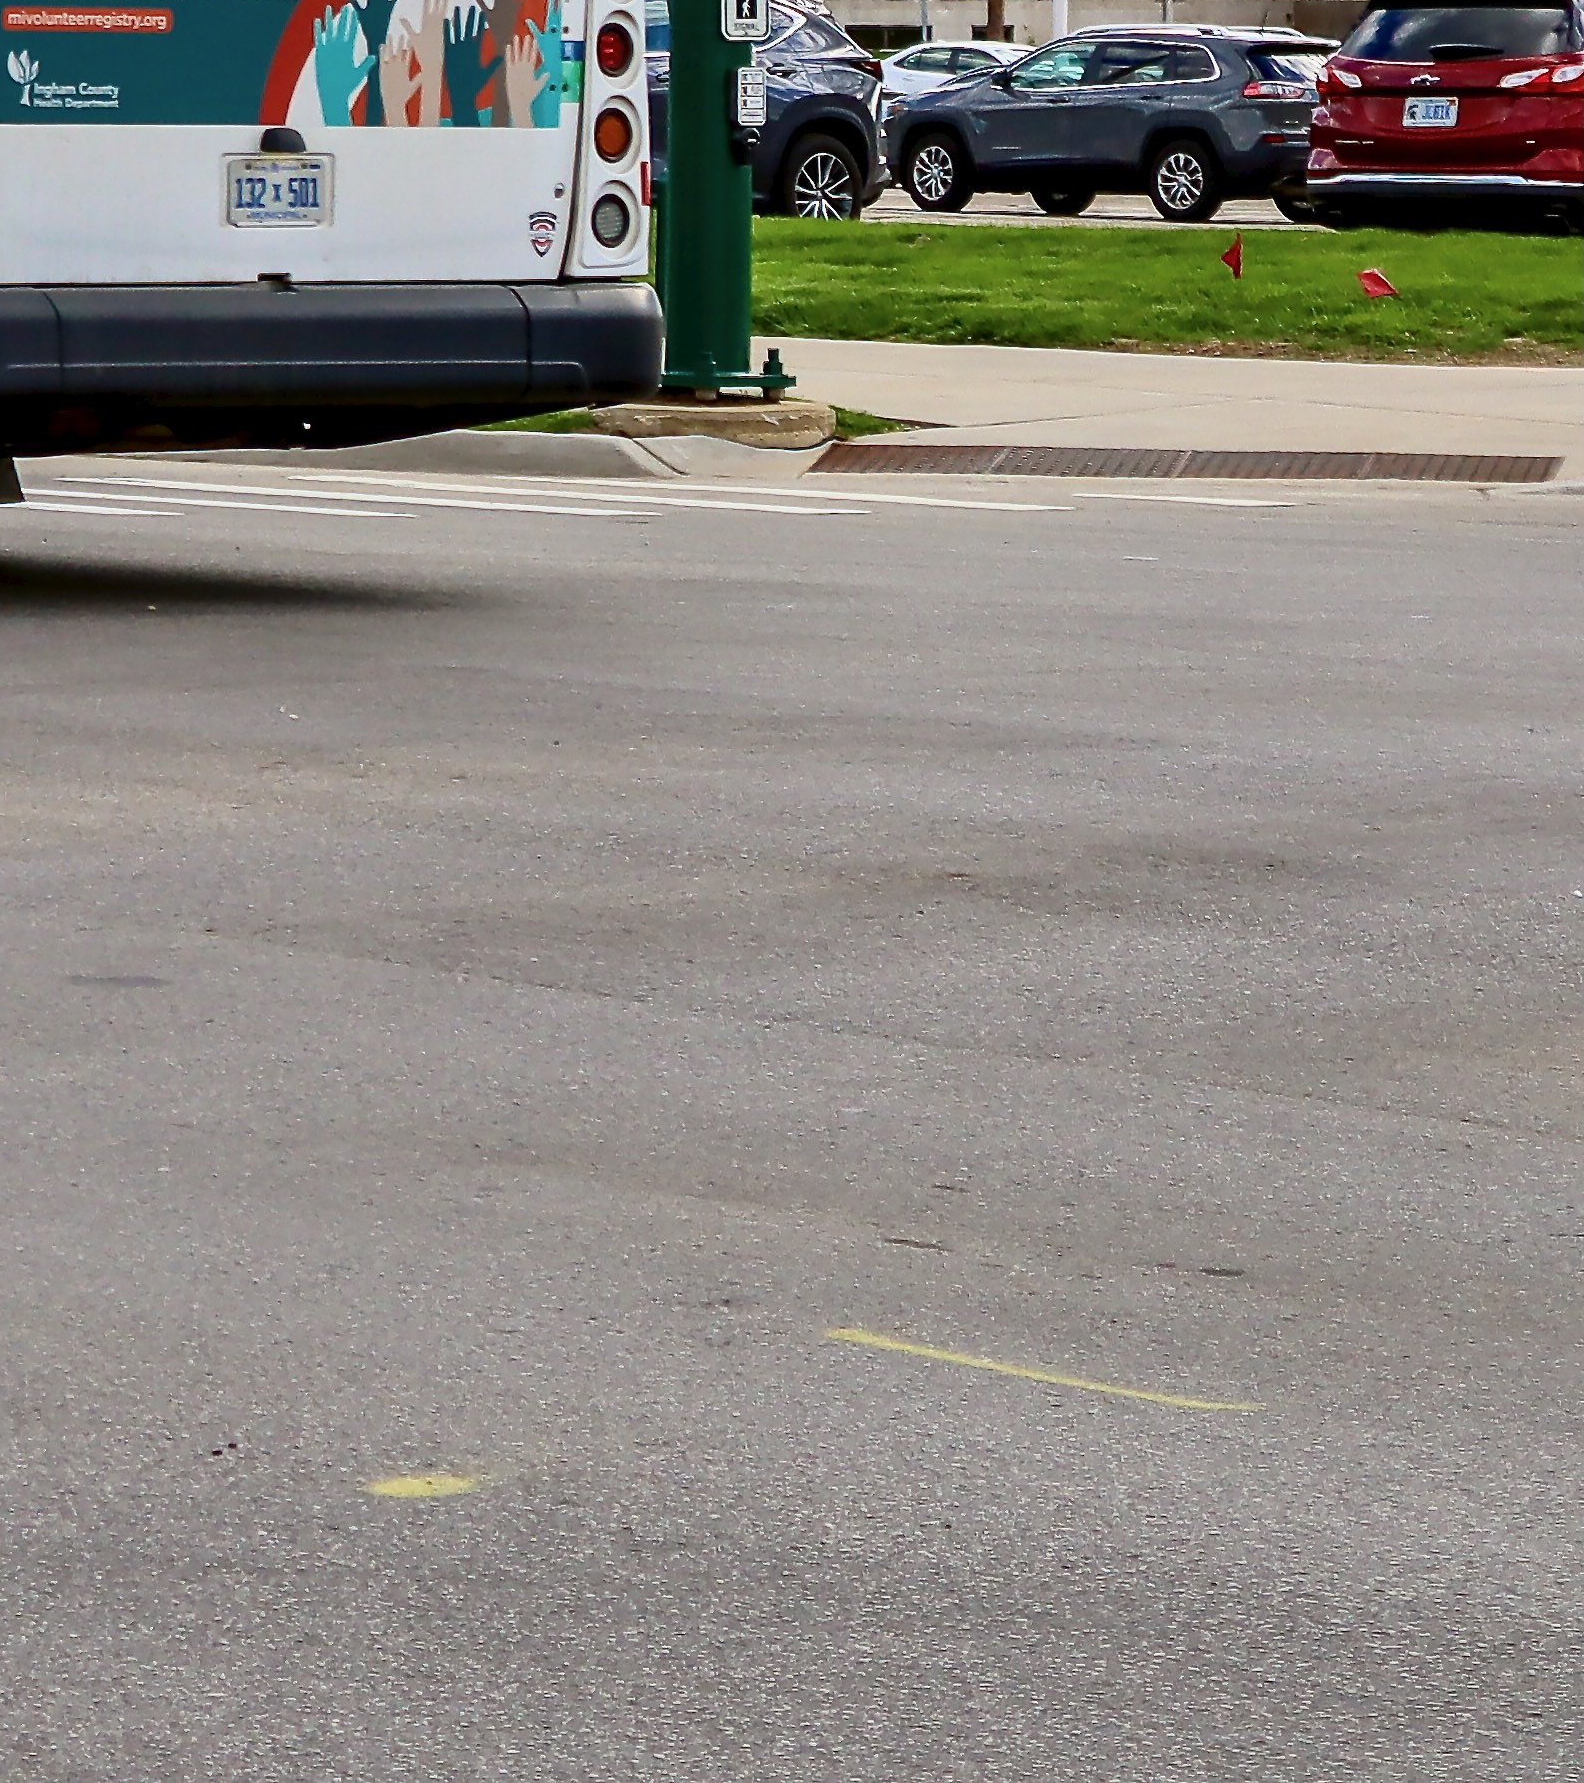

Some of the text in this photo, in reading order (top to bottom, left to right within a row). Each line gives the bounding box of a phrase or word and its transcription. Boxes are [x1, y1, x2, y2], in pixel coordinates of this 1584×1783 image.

[7, 11, 167, 30] mivolunteerregistry.org
[33, 82, 119, 98] Ingham County
[235, 178, 267, 208] 132
[287, 178, 320, 208] 501
